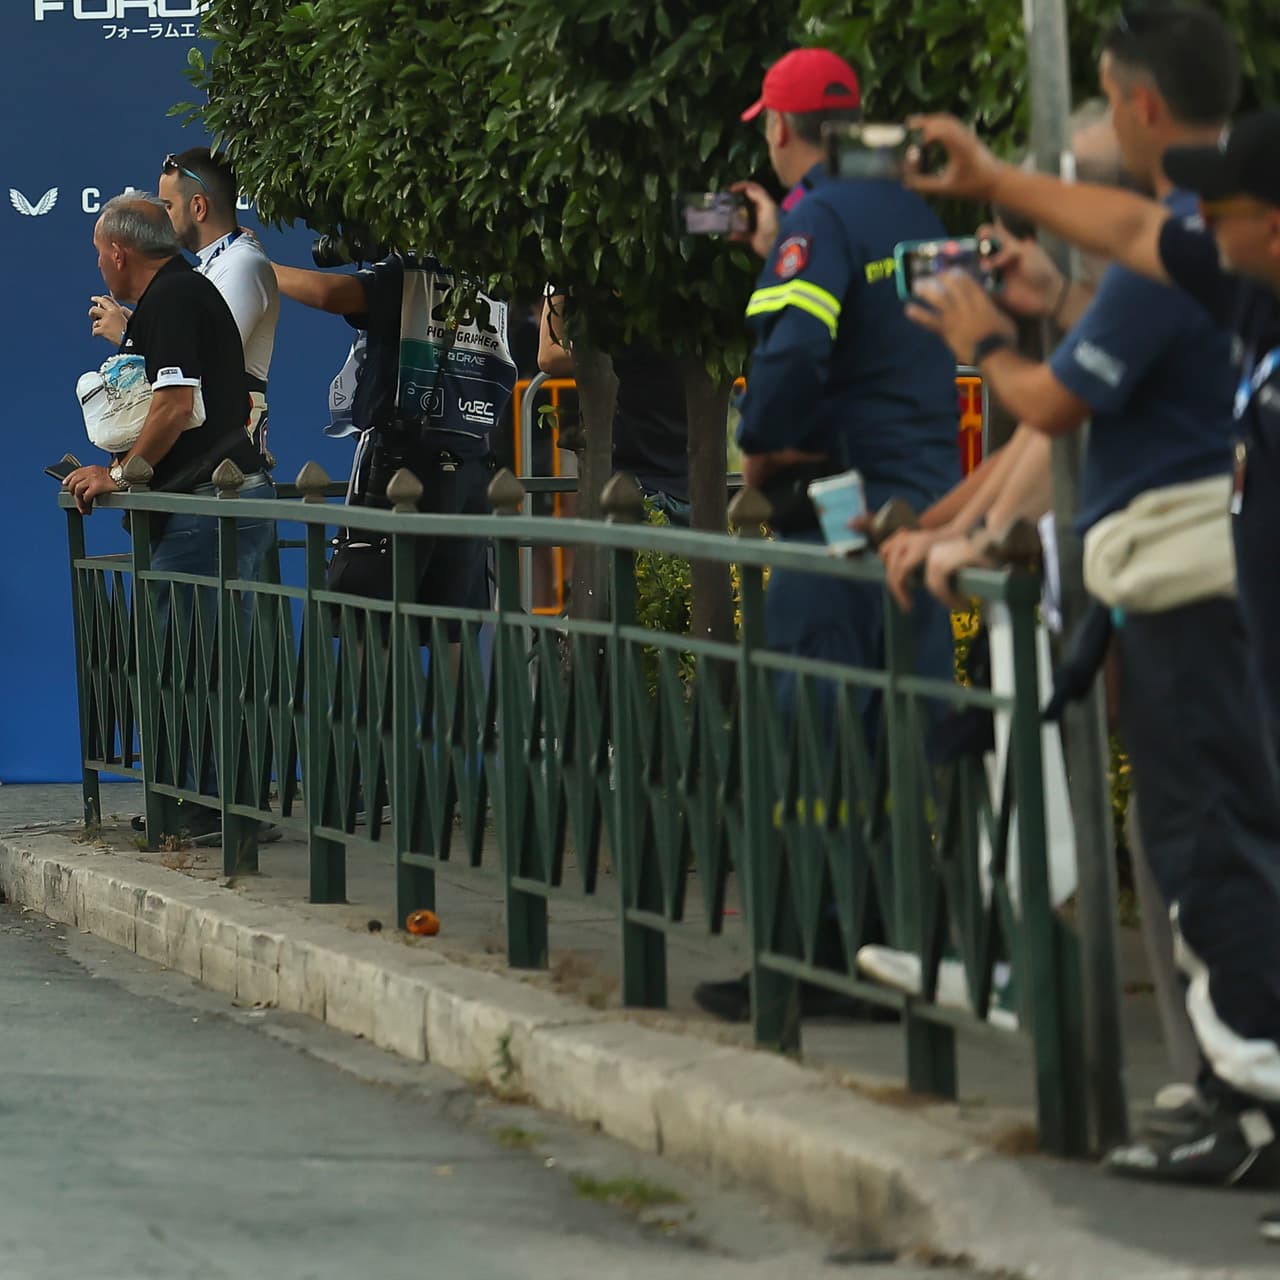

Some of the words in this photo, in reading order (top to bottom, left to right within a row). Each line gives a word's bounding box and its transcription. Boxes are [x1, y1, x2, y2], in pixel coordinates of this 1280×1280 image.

[102, 23, 198, 40] フォーラムエ
[458, 397, 494, 417] WRC
